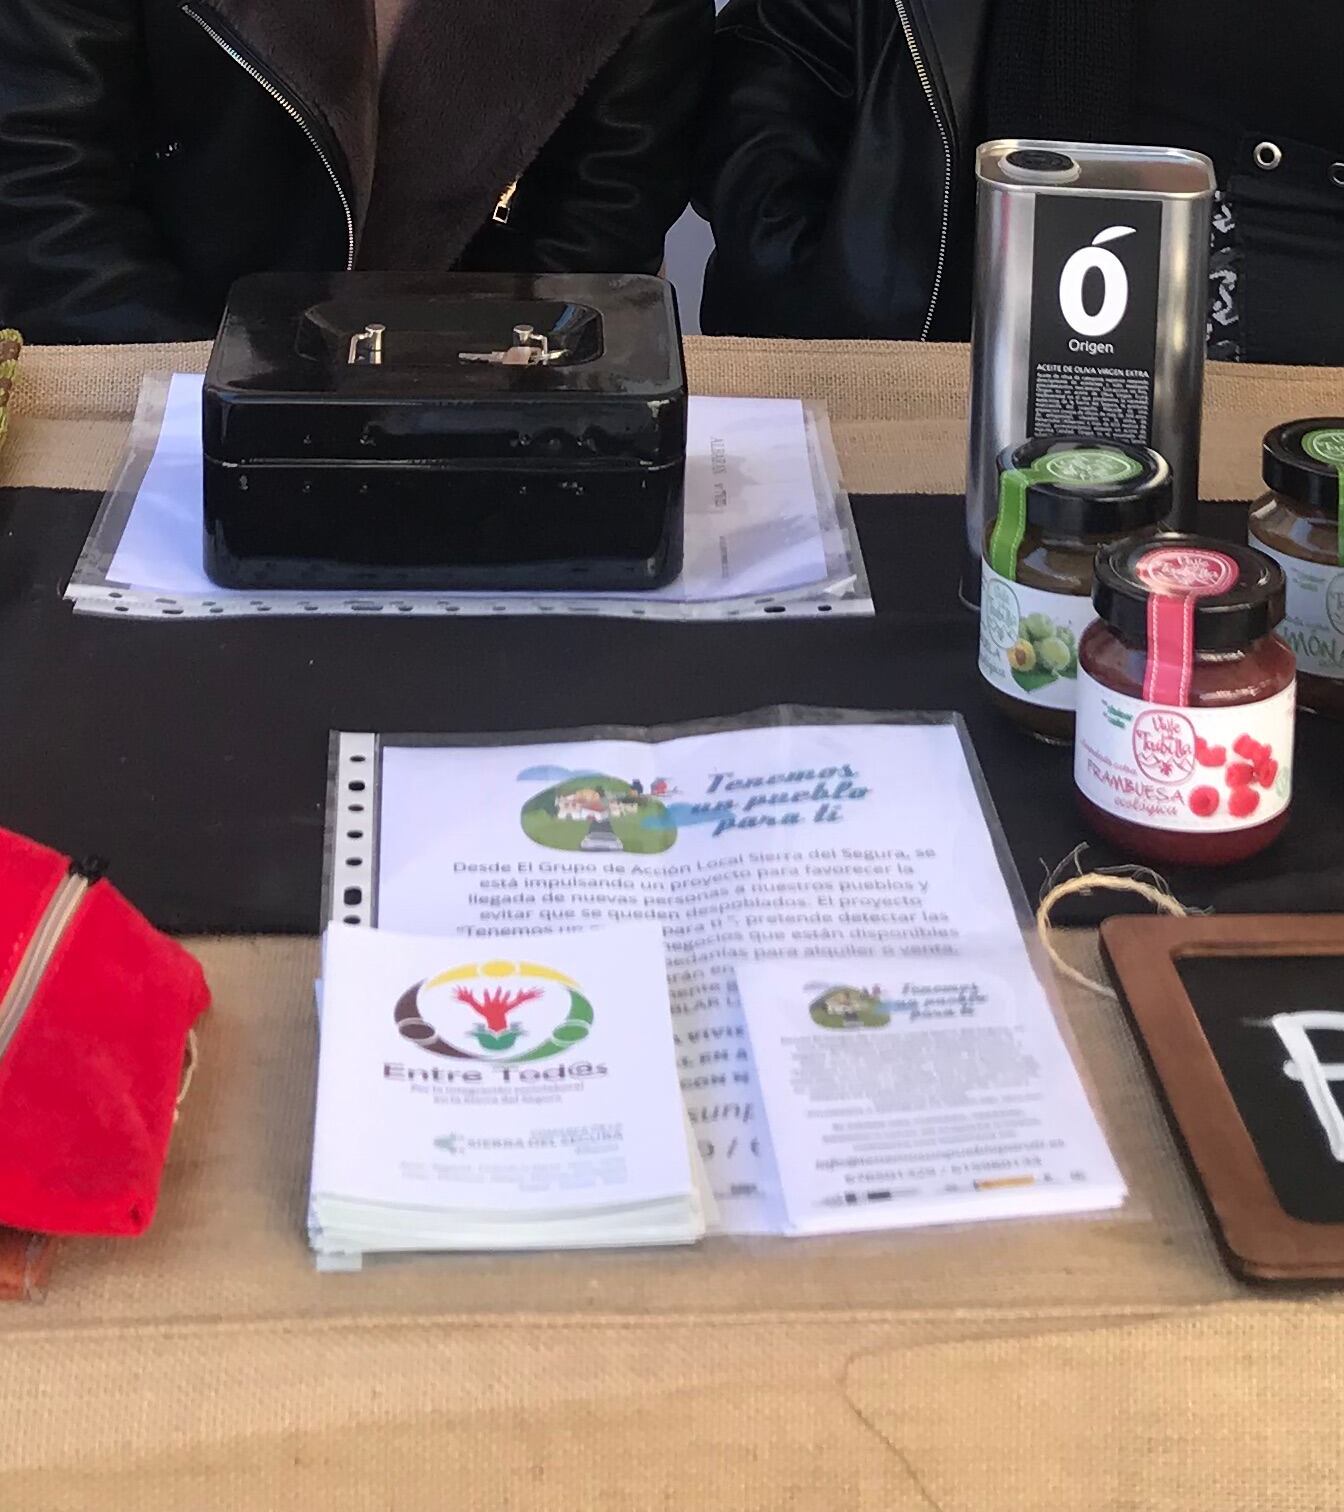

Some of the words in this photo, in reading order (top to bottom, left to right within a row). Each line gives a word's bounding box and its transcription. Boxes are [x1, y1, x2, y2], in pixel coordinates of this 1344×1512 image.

[1068, 338, 1114, 355] Origen
[706, 762, 861, 795] Tenemos
[1087, 758, 1185, 805] FRAMBUESA
[744, 781, 873, 813] pueblo
[711, 808, 802, 838] para
[453, 861, 513, 875] Desde
[538, 861, 598, 876] Grupo
[603, 861, 626, 875] de
[748, 850, 804, 864] Sierra
[808, 847, 837, 861] del
[479, 876, 519, 890] está
[524, 876, 636, 892] impulsando
[669, 868, 753, 894] proyecto
[756, 864, 801, 881] para
[804, 863, 894, 877] favorecer
[896, 862, 916, 876] la
[467, 893, 537, 908] llegada
[541, 892, 566, 904] de
[570, 893, 639, 906] nuevas
[642, 886, 730, 908] personas
[751, 879, 836, 893] nuestros
[839, 878, 915, 894] pueblos
[917, 880, 930, 895] y
[479, 908, 534, 921] evitar
[538, 909, 577, 923] que
[581, 908, 604, 920] se
[607, 908, 682, 923] queden
[839, 895, 924, 911] proyecto
[745, 911, 834, 928] pretende
[837, 909, 920, 924] detectar
[848, 925, 961, 941] disponibles
[382, 1061, 484, 1084] Entre
